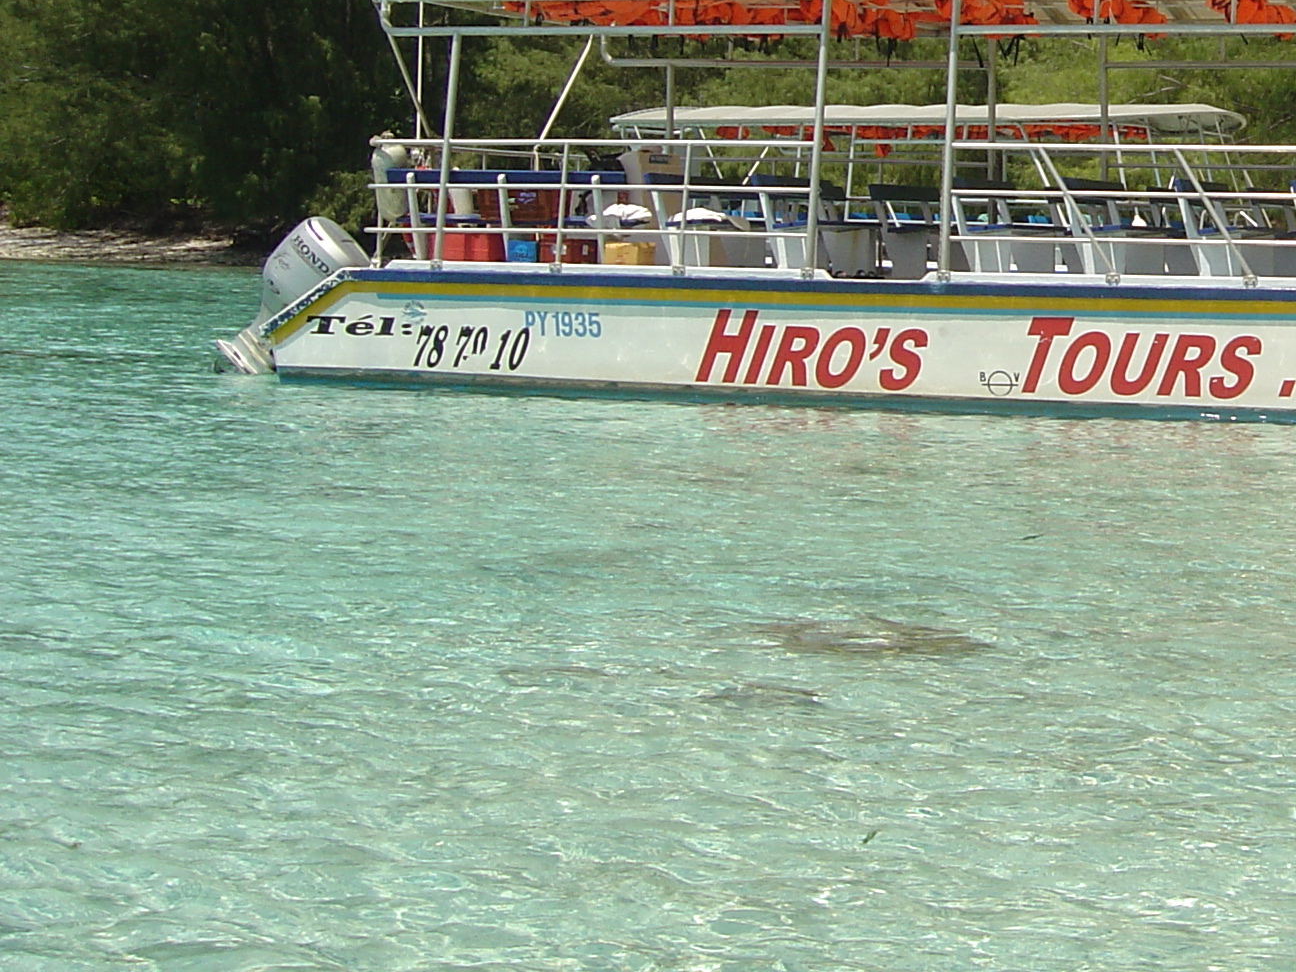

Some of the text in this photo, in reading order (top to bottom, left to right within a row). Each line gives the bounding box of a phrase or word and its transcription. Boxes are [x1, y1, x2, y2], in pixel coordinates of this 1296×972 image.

[306, 314, 413, 336] Tél:
[413, 324, 449, 368] 78
[490, 327, 530, 371] 10
[695, 308, 929, 391] HIRO'S
[1021, 316, 1262, 399] TOURS
